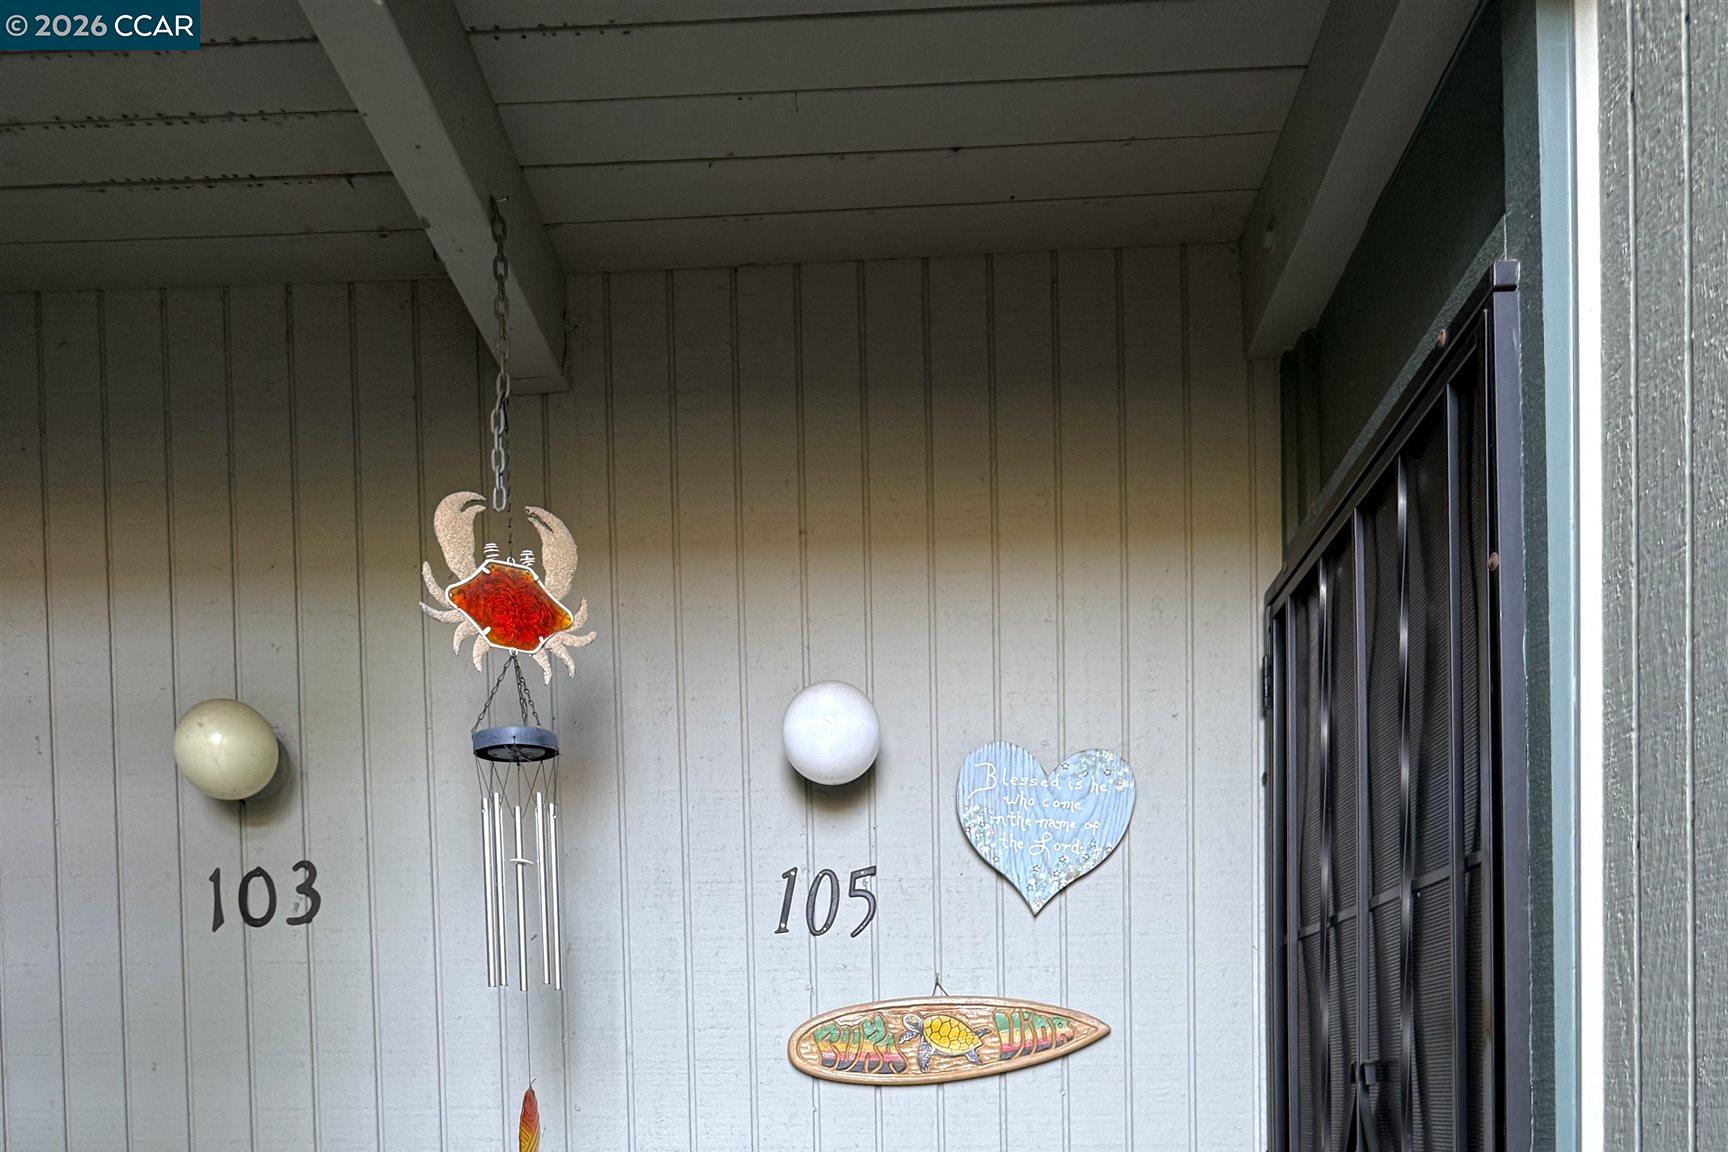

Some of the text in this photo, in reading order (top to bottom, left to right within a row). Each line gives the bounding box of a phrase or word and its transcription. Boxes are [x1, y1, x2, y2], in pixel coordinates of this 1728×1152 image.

[968, 762, 1108, 799] Blessed is he
[1003, 790, 1082, 813] who come
[990, 811, 1101, 835] in the name of
[1000, 832, 1024, 853] the
[209, 860, 322, 933] 103
[774, 865, 877, 938] 105
